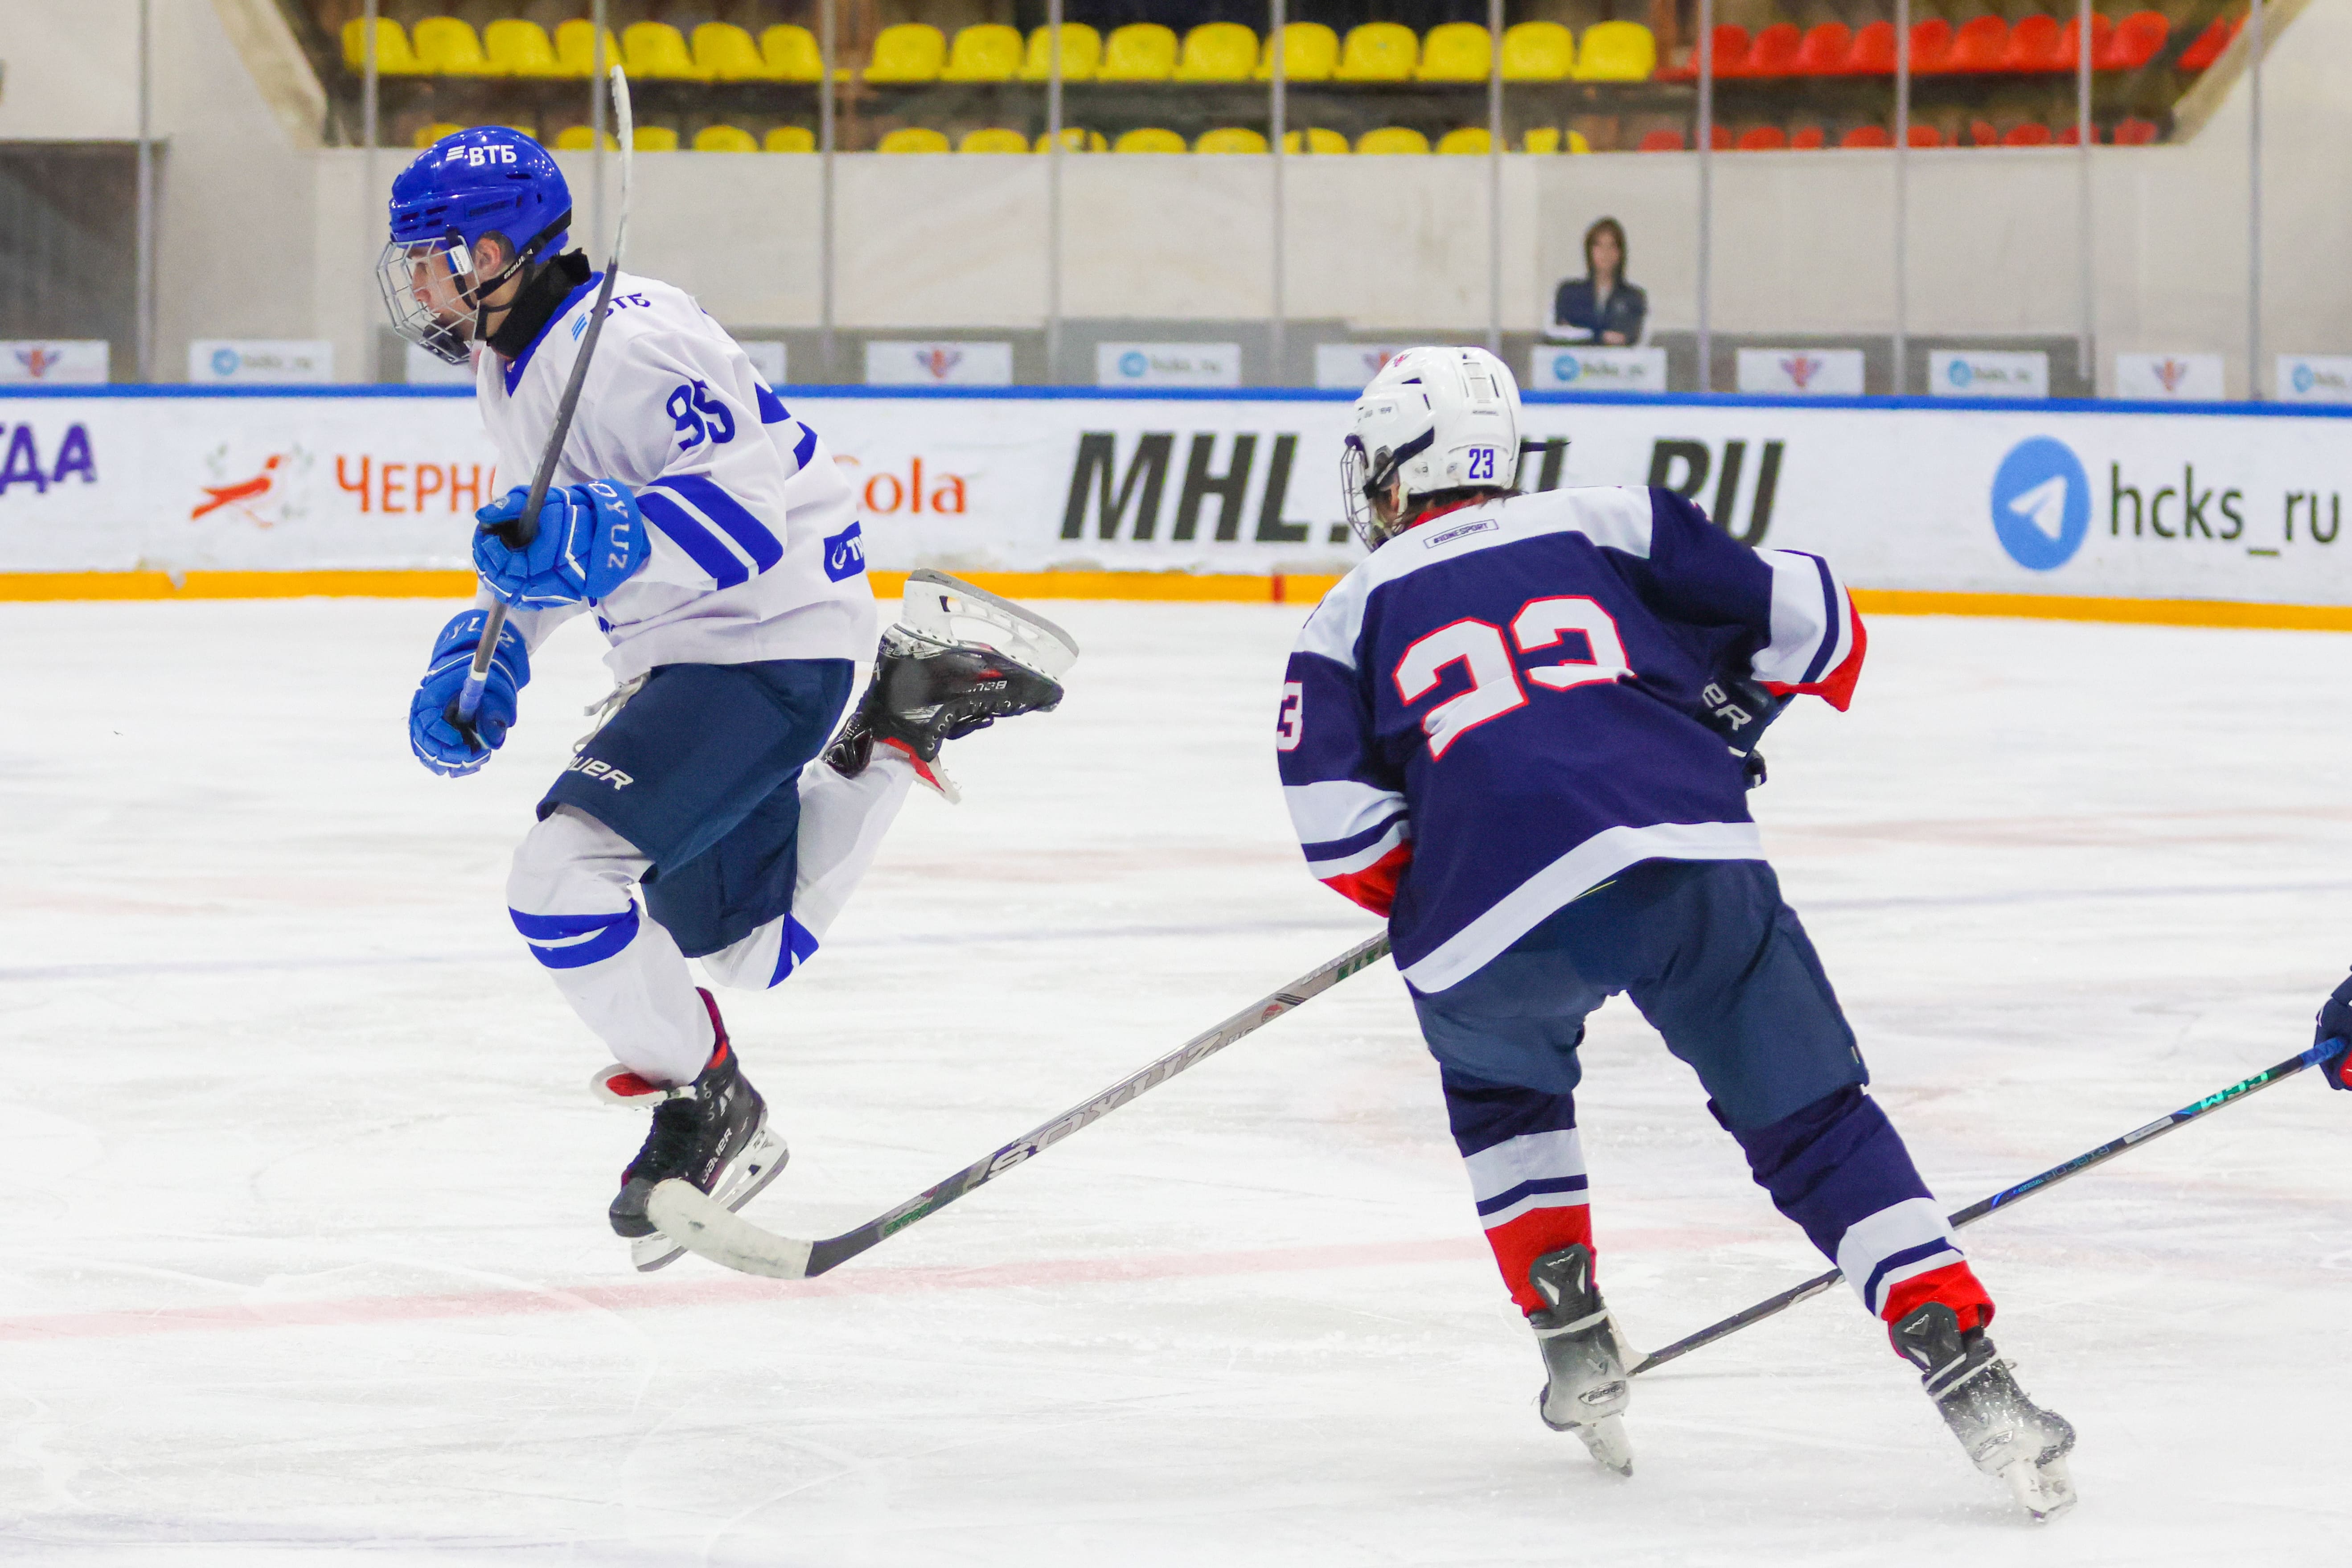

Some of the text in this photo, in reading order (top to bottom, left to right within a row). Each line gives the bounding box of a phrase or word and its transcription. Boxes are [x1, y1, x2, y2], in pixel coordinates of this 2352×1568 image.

[469, 145, 517, 166] ВТБ
[667, 379, 735, 451] 95
[0, 424, 97, 495] ДА
[336, 455, 496, 513] ЧЕРН
[1469, 448, 1494, 479] 23
[588, 480, 630, 569] OYUZ
[2110, 461, 2341, 557] hcks_ru
[567, 756, 634, 790] UER
